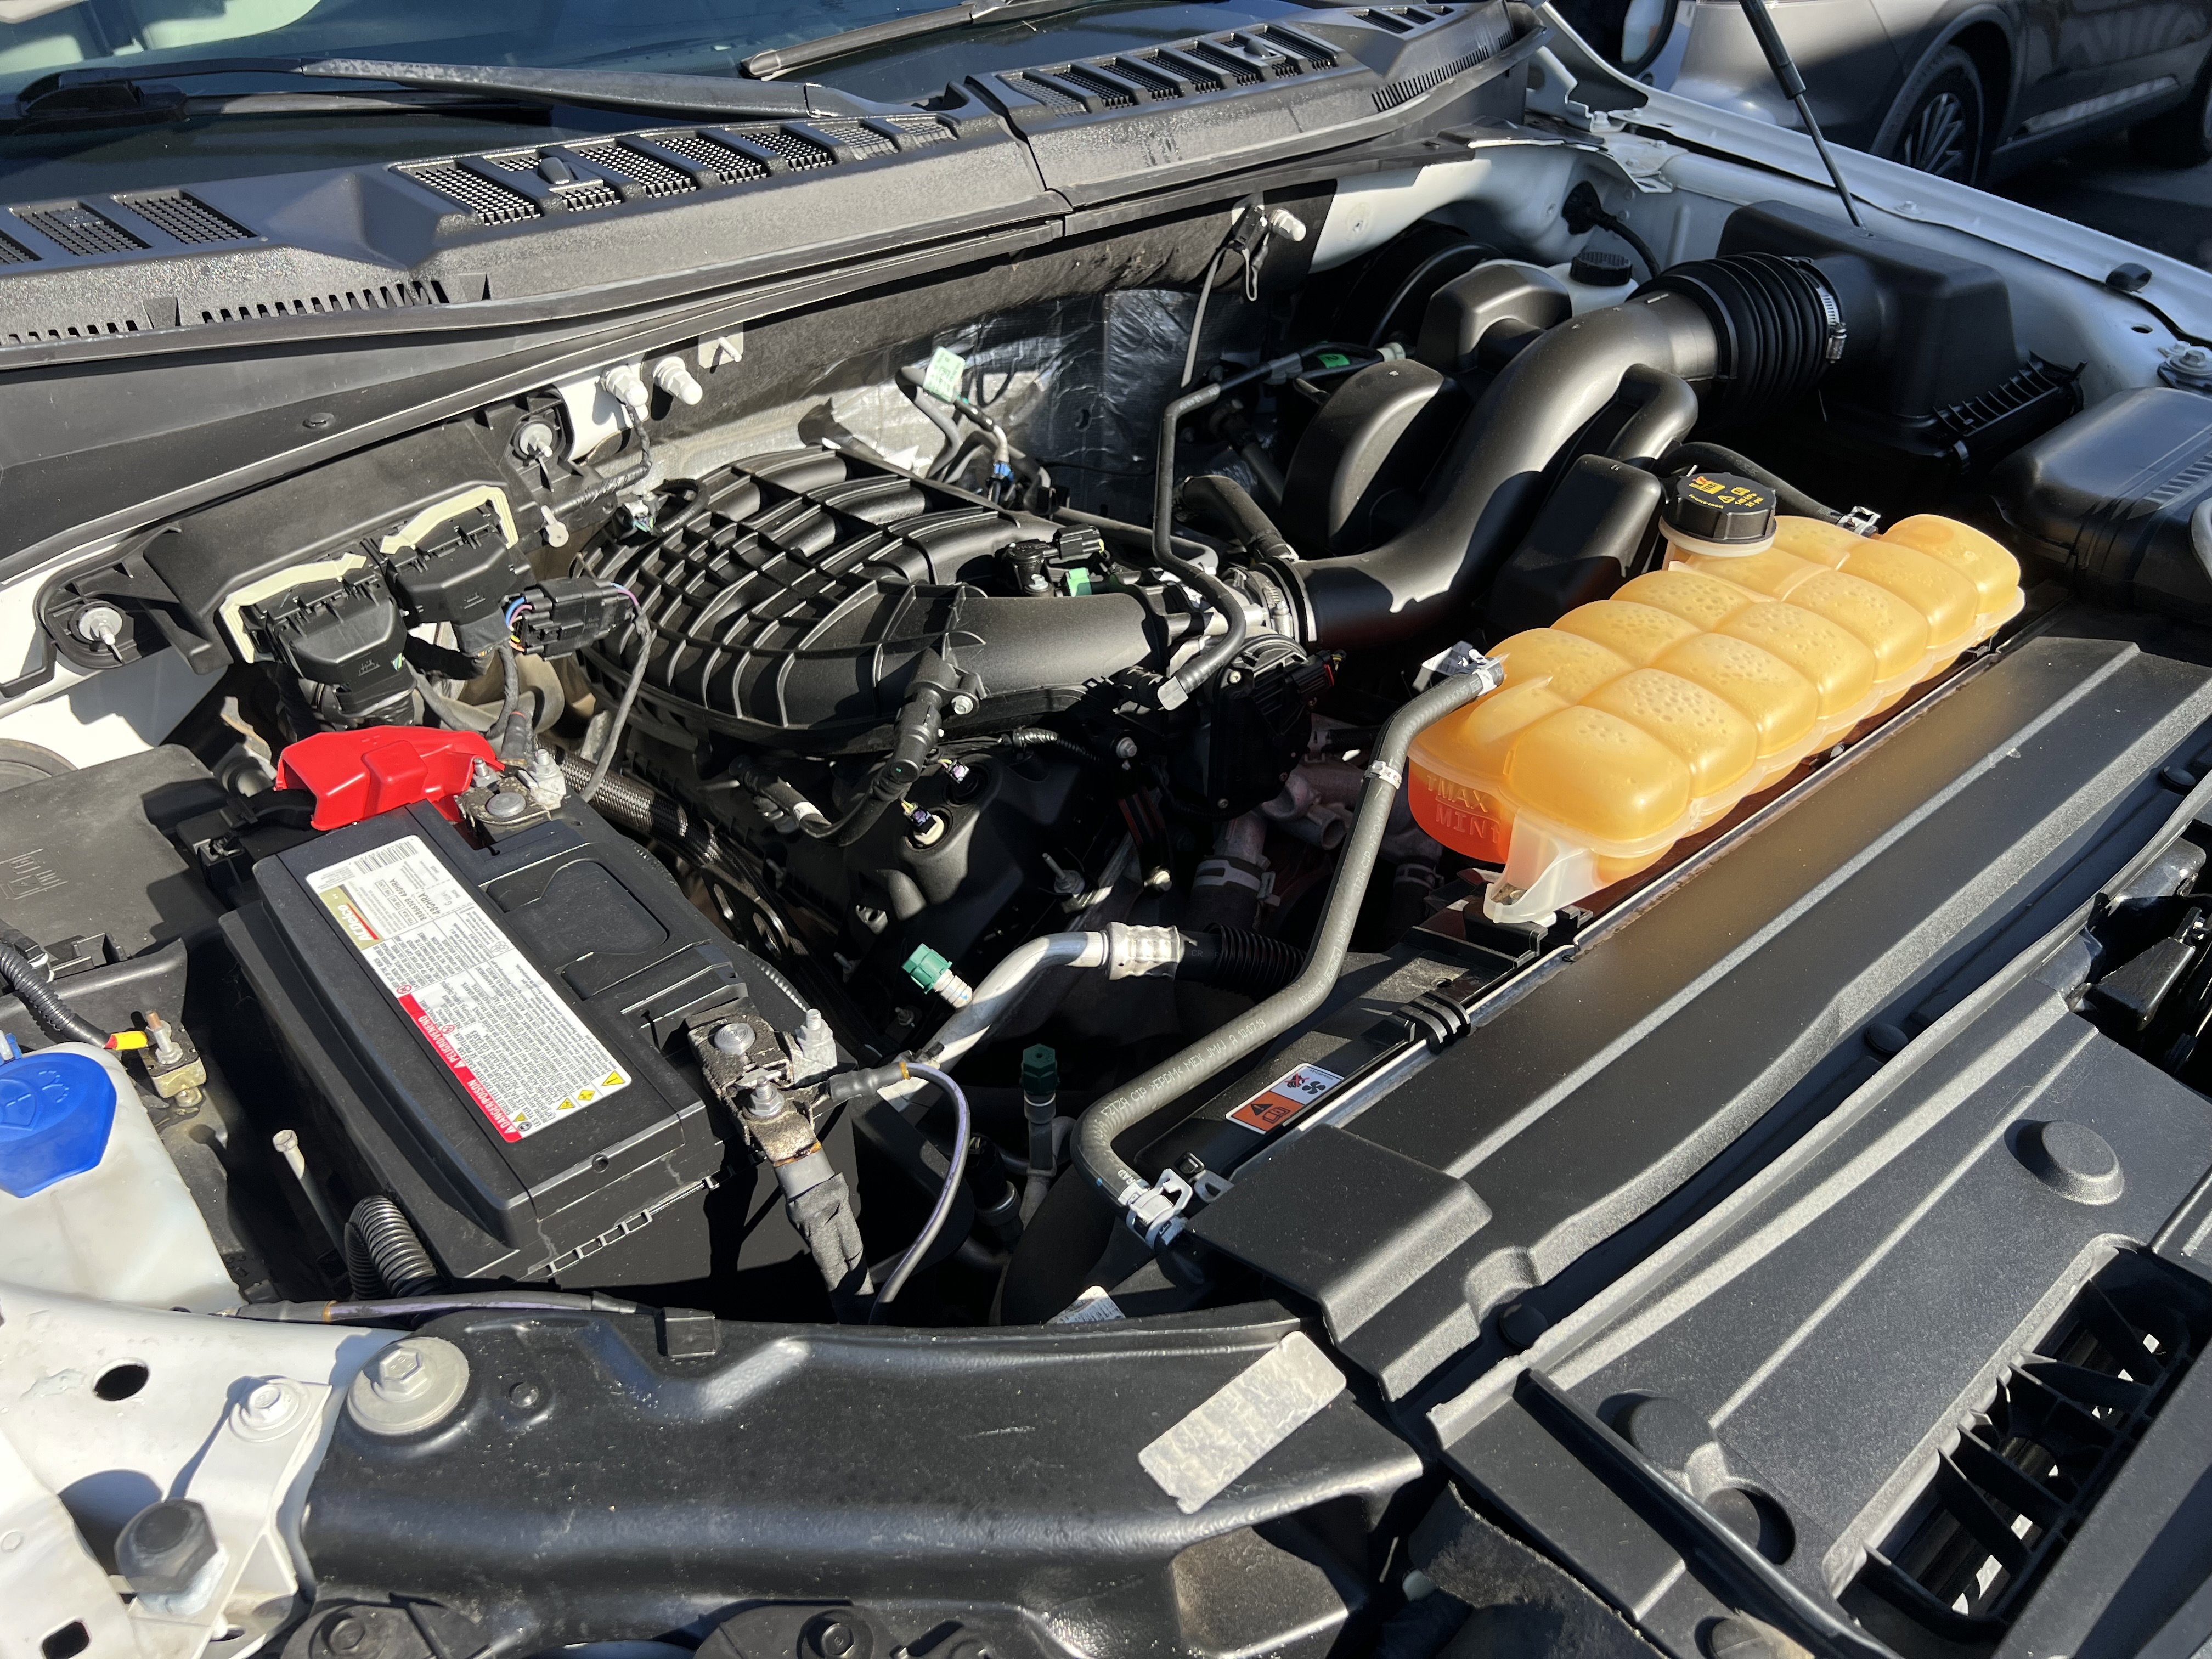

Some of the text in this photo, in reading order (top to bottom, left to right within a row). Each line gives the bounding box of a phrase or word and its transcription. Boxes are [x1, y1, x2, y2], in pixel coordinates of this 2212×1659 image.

[1437, 780, 1488, 813] MAX
[1436, 805, 1486, 838] MIN
[416, 891, 442, 916] 48GHRA
[334, 903, 373, 944] ACDelco
[416, 1014, 460, 1063] PELIGRO/VENENO
[470, 1029, 485, 1043] GASES
[495, 1036, 515, 1056] BLINDNESS
[507, 1039, 522, 1053] CAUSER
[462, 1054, 477, 1069] GASES
[510, 1054, 524, 1068] CAUSE
[472, 1068, 493, 1090] EXPLOSIVE
[492, 1069, 513, 1091] EXPLOSIFS
[502, 1069, 521, 1089] PROTEJA
[507, 1064, 523, 1080] CAUSAR
[526, 1061, 549, 1086] SULFURIQUE
[526, 1074, 539, 1086] ACID
[489, 1088, 501, 1101] EYES
[490, 1077, 510, 1099] BLINDNESS
[534, 1084, 555, 1105] SULFURIC
[466, 1077, 511, 1128] DANGER/POISON
[498, 1099, 514, 1115] SHIELD
[505, 1097, 520, 1111] CAUSE
[531, 1093, 555, 1120] EXPLOSIVOS
